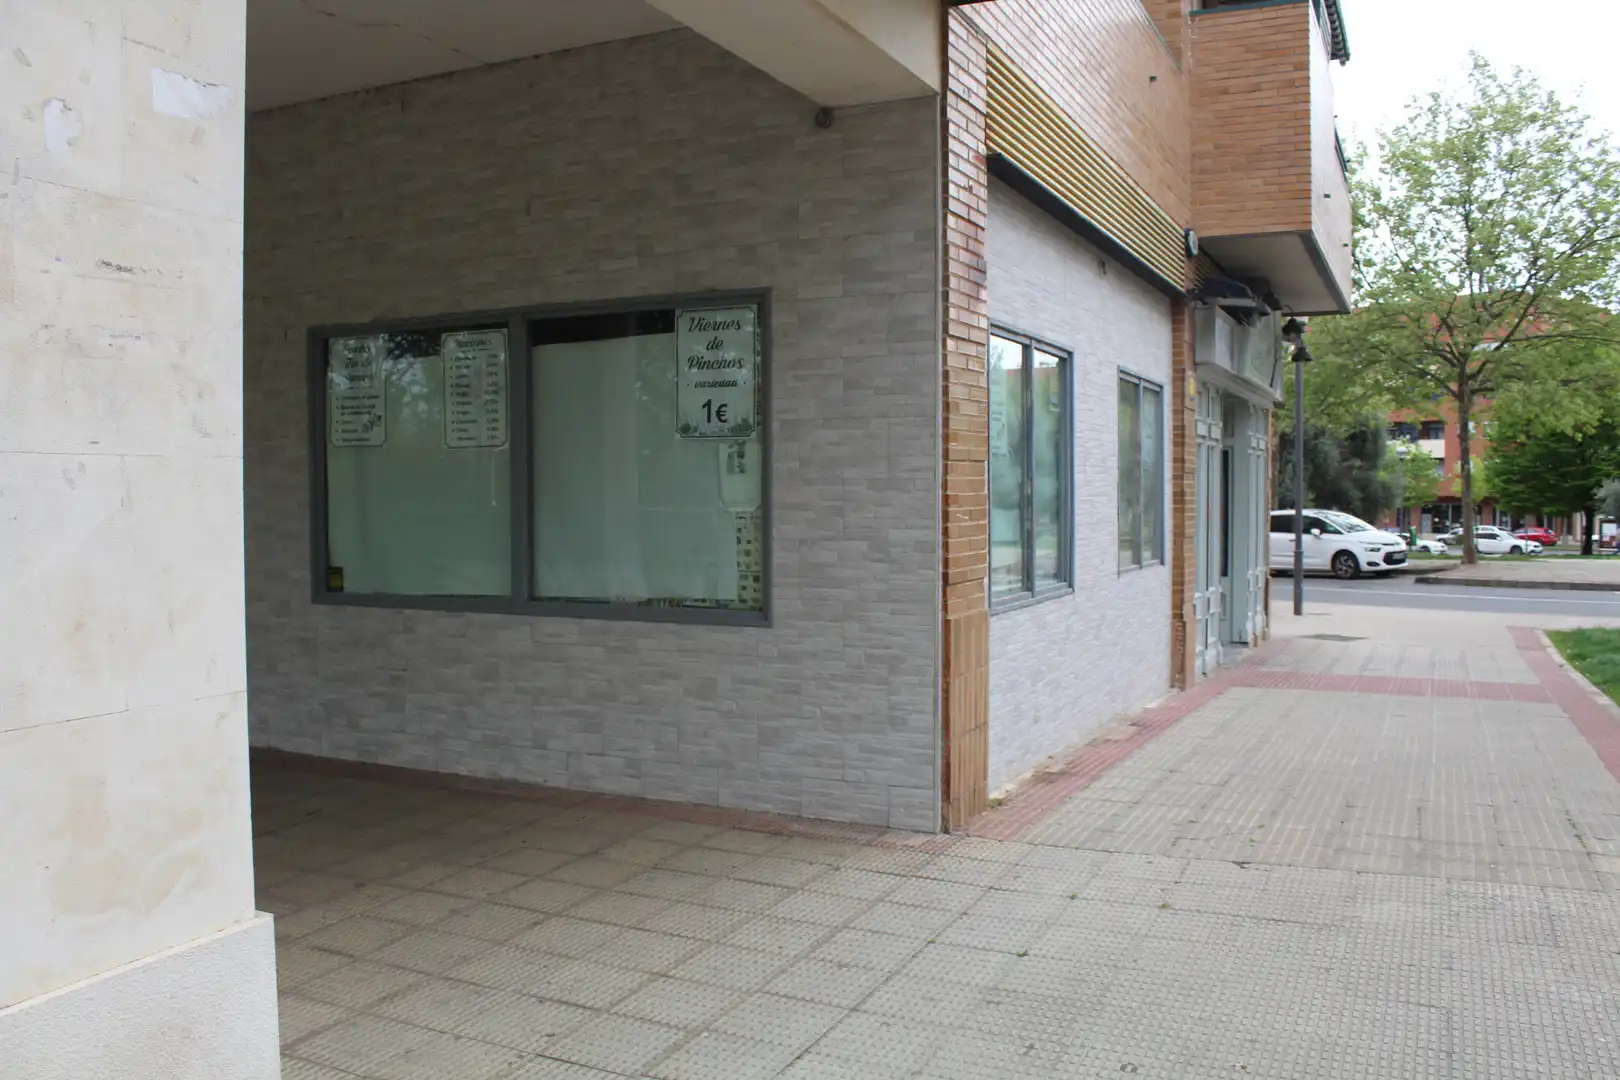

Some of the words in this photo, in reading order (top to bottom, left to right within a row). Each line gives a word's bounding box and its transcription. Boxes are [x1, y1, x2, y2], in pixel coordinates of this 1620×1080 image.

[688, 317, 742, 332] Viernes
[706, 336, 724, 351] de
[687, 354, 744, 370] Pinchos
[701, 399, 728, 423] 1€
